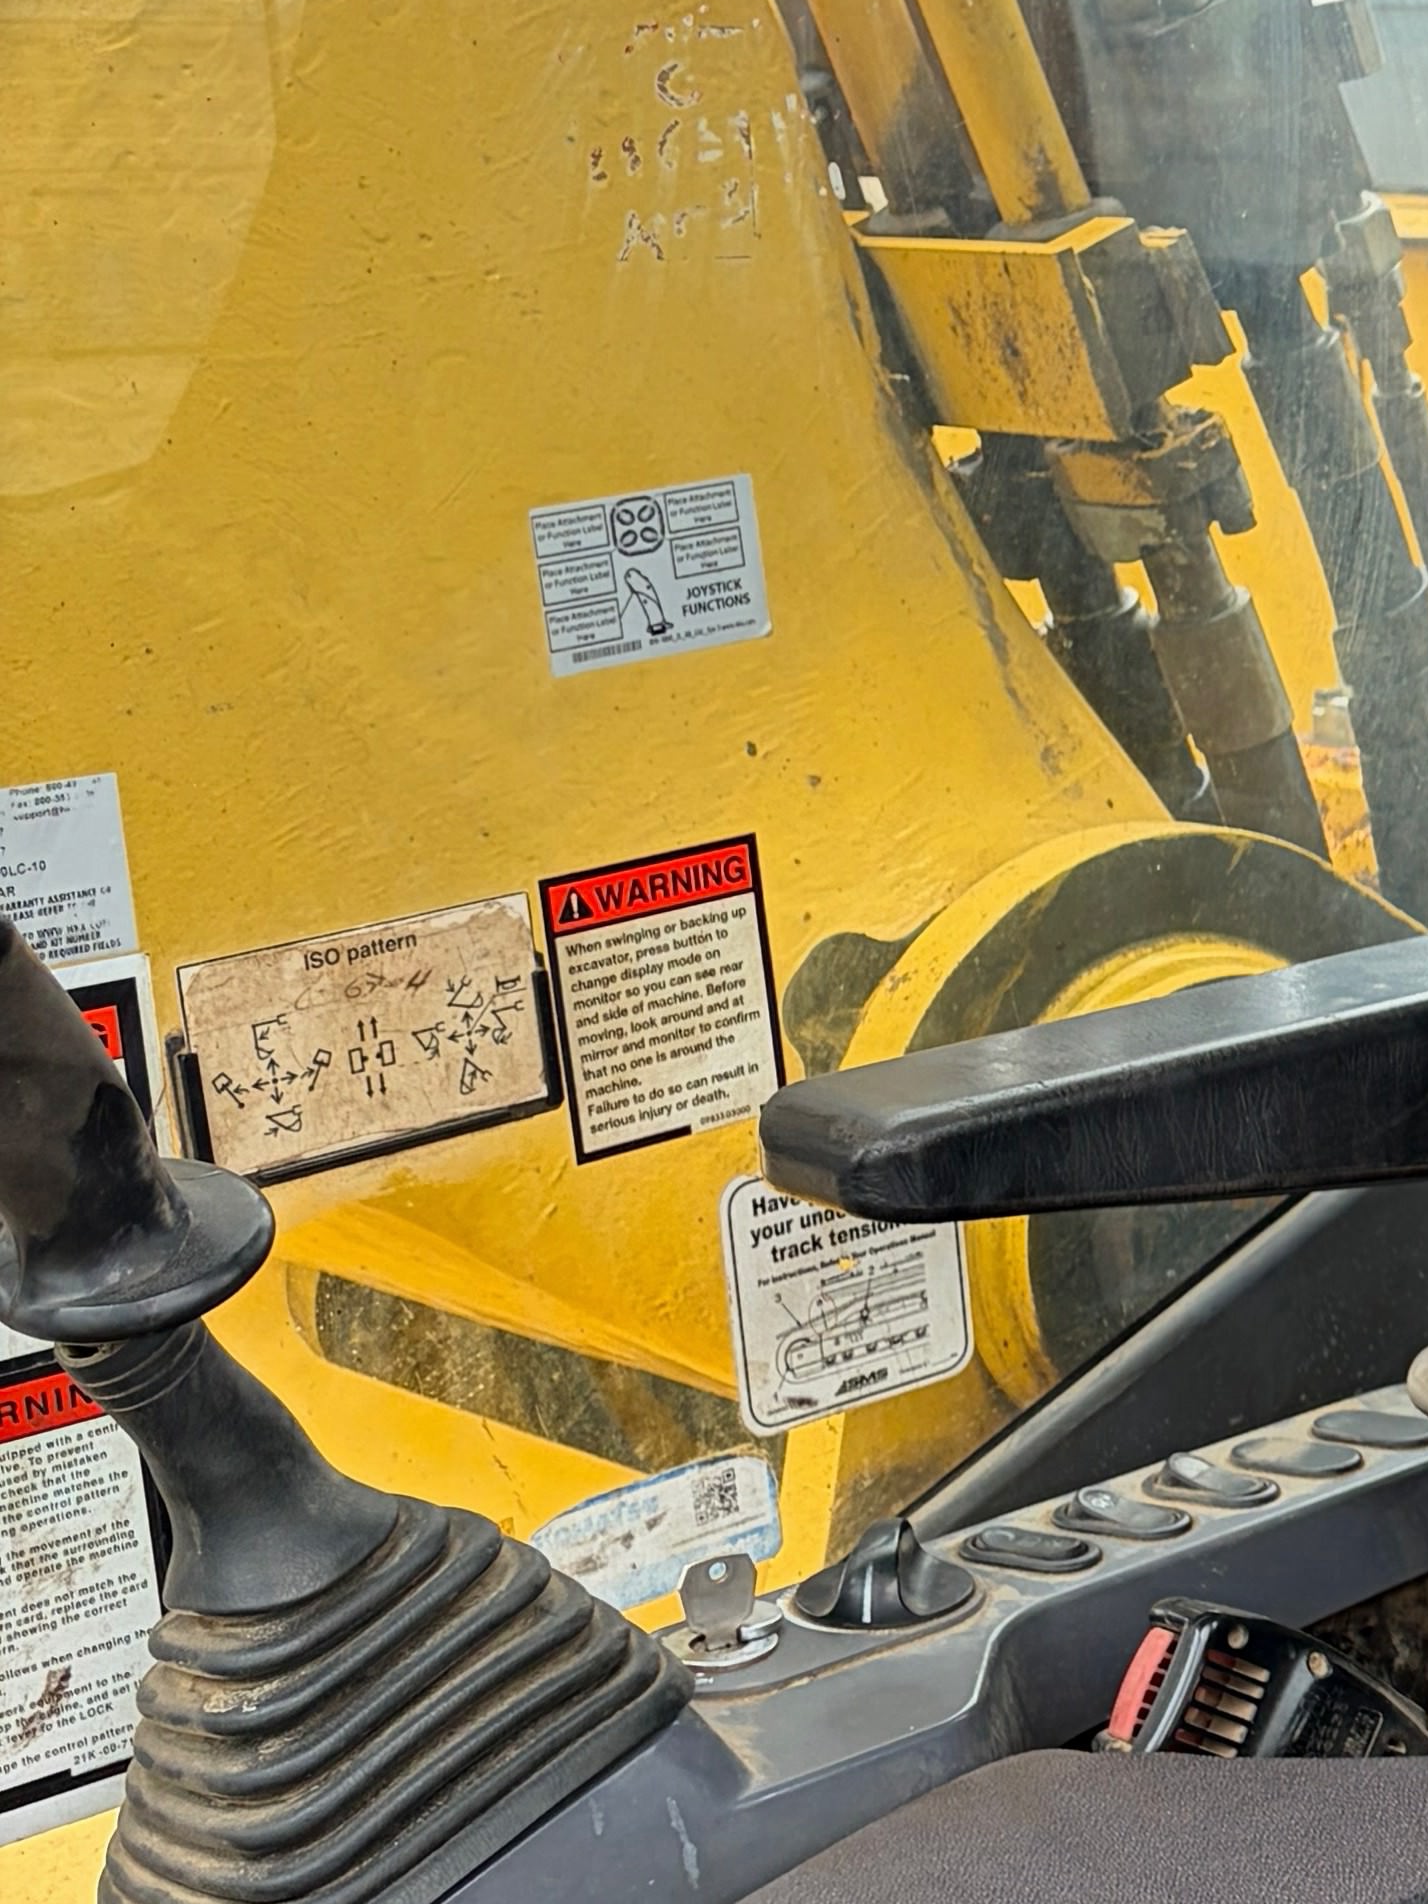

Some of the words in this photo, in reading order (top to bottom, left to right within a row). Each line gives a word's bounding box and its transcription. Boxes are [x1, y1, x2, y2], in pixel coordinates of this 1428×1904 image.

[681, 592, 751, 616] FUNCTIONS
[685, 578, 742, 599] JOYSTICK
[595, 853, 746, 915] WARNING
[304, 947, 340, 971] ISO
[347, 934, 417, 962] pattern
[565, 937, 601, 958] When
[605, 923, 660, 951] swinging
[663, 922, 676, 934] or
[679, 907, 728, 932] backing
[731, 906, 746, 921] up
[568, 949, 632, 978] excavator,
[636, 941, 670, 962] press
[672, 929, 712, 950] button
[715, 926, 728, 940] to
[570, 970, 616, 996] change
[619, 958, 664, 984] display
[667, 950, 701, 970] mode
[705, 948, 720, 961] on
[573, 987, 622, 1013] monitor
[625, 985, 639, 998] so
[643, 978, 666, 996] you
[669, 973, 691, 988] can
[695, 966, 716, 981] see
[720, 960, 743, 974] rear
[575, 1012, 599, 1029] and
[602, 1005, 628, 1023] side
[631, 1001, 644, 1015] of
[647, 985, 703, 1013] machine.
[706, 974, 746, 997] Before
[578, 1023, 627, 1050] moving,
[630, 1015, 657, 1034] look
[660, 1004, 703, 1027] around
[706, 997, 729, 1014] and
[732, 994, 744, 1007] at
[580, 1043, 619, 1066] mirror
[622, 1037, 645, 1055] and
[648, 1023, 695, 1049] monitor
[698, 1020, 711, 1034] to
[714, 1006, 759, 1031] confirm
[583, 1064, 607, 1082] that
[610, 1061, 626, 1075] no
[630, 1054, 652, 1070] one
[655, 1050, 666, 1063] is
[669, 1037, 712, 1061] around
[715, 1031, 734, 1047] the
[585, 1072, 641, 1101] machine.
[588, 1093, 629, 1119] Failure
[632, 1090, 645, 1105] to
[648, 1085, 664, 1101] do
[668, 1081, 682, 1095] so
[686, 1074, 708, 1091] can
[711, 1063, 744, 1084] result
[747, 1059, 758, 1073] in
[589, 1110, 635, 1136] serious
[638, 1100, 672, 1125] injury
[675, 1097, 688, 1112] or
[691, 1084, 729, 1109] death.
[750, 1217, 793, 1247] your
[771, 1232, 822, 1264] track
[28, 1454, 42, 1467] To
[47, 1441, 93, 1463] prevent
[46, 1433, 71, 1449] with
[76, 1432, 82, 1440] a
[1, 1481, 37, 1500] check
[42, 1473, 66, 1488] that
[71, 1467, 90, 1480] the
[33, 1466, 45, 1480] by
[51, 1449, 107, 1473] mistaken
[53, 1475, 104, 1498] matches
[108, 1468, 128, 1482] the
[3, 1510, 22, 1525] the
[26, 1497, 71, 1518] control
[75, 1483, 119, 1505] pattern
[21, 1504, 91, 1534] operations.
[6, 1547, 25, 1561] the
[29, 1528, 91, 1555] movement
[95, 1523, 106, 1535] of
[111, 1516, 129, 1531] the
[11, 1556, 34, 1572] that
[39, 1550, 57, 1564] the
[63, 1527, 134, 1559] surrounding
[16, 1561, 62, 1583] operate
[66, 1554, 84, 1567] the
[89, 1537, 138, 1561] machine
[22, 1597, 49, 1614] does
[54, 1589, 74, 1604] not
[78, 1577, 113, 1597] match
[118, 1570, 136, 1584] the
[51, 1595, 95, 1619] replace
[99, 1588, 118, 1601] the
[121, 1578, 148, 1595] card
[6, 1618, 56, 1644] showing
[61, 1611, 79, 1626] the
[84, 1597, 127, 1619] correct
[41, 1650, 72, 1669] when
[76, 1631, 131, 1660] changing
[86, 1690, 108, 1705] and
[112, 1683, 130, 1697] set
[96, 1676, 108, 1688] to
[112, 1669, 130, 1683] the
[41, 1722, 52, 1733] to
[57, 1713, 75, 1728] the
[80, 1700, 113, 1720] LOCK
[22, 1752, 40, 1767] the
[45, 1736, 87, 1760] control
[91, 1721, 133, 1744] pattern
